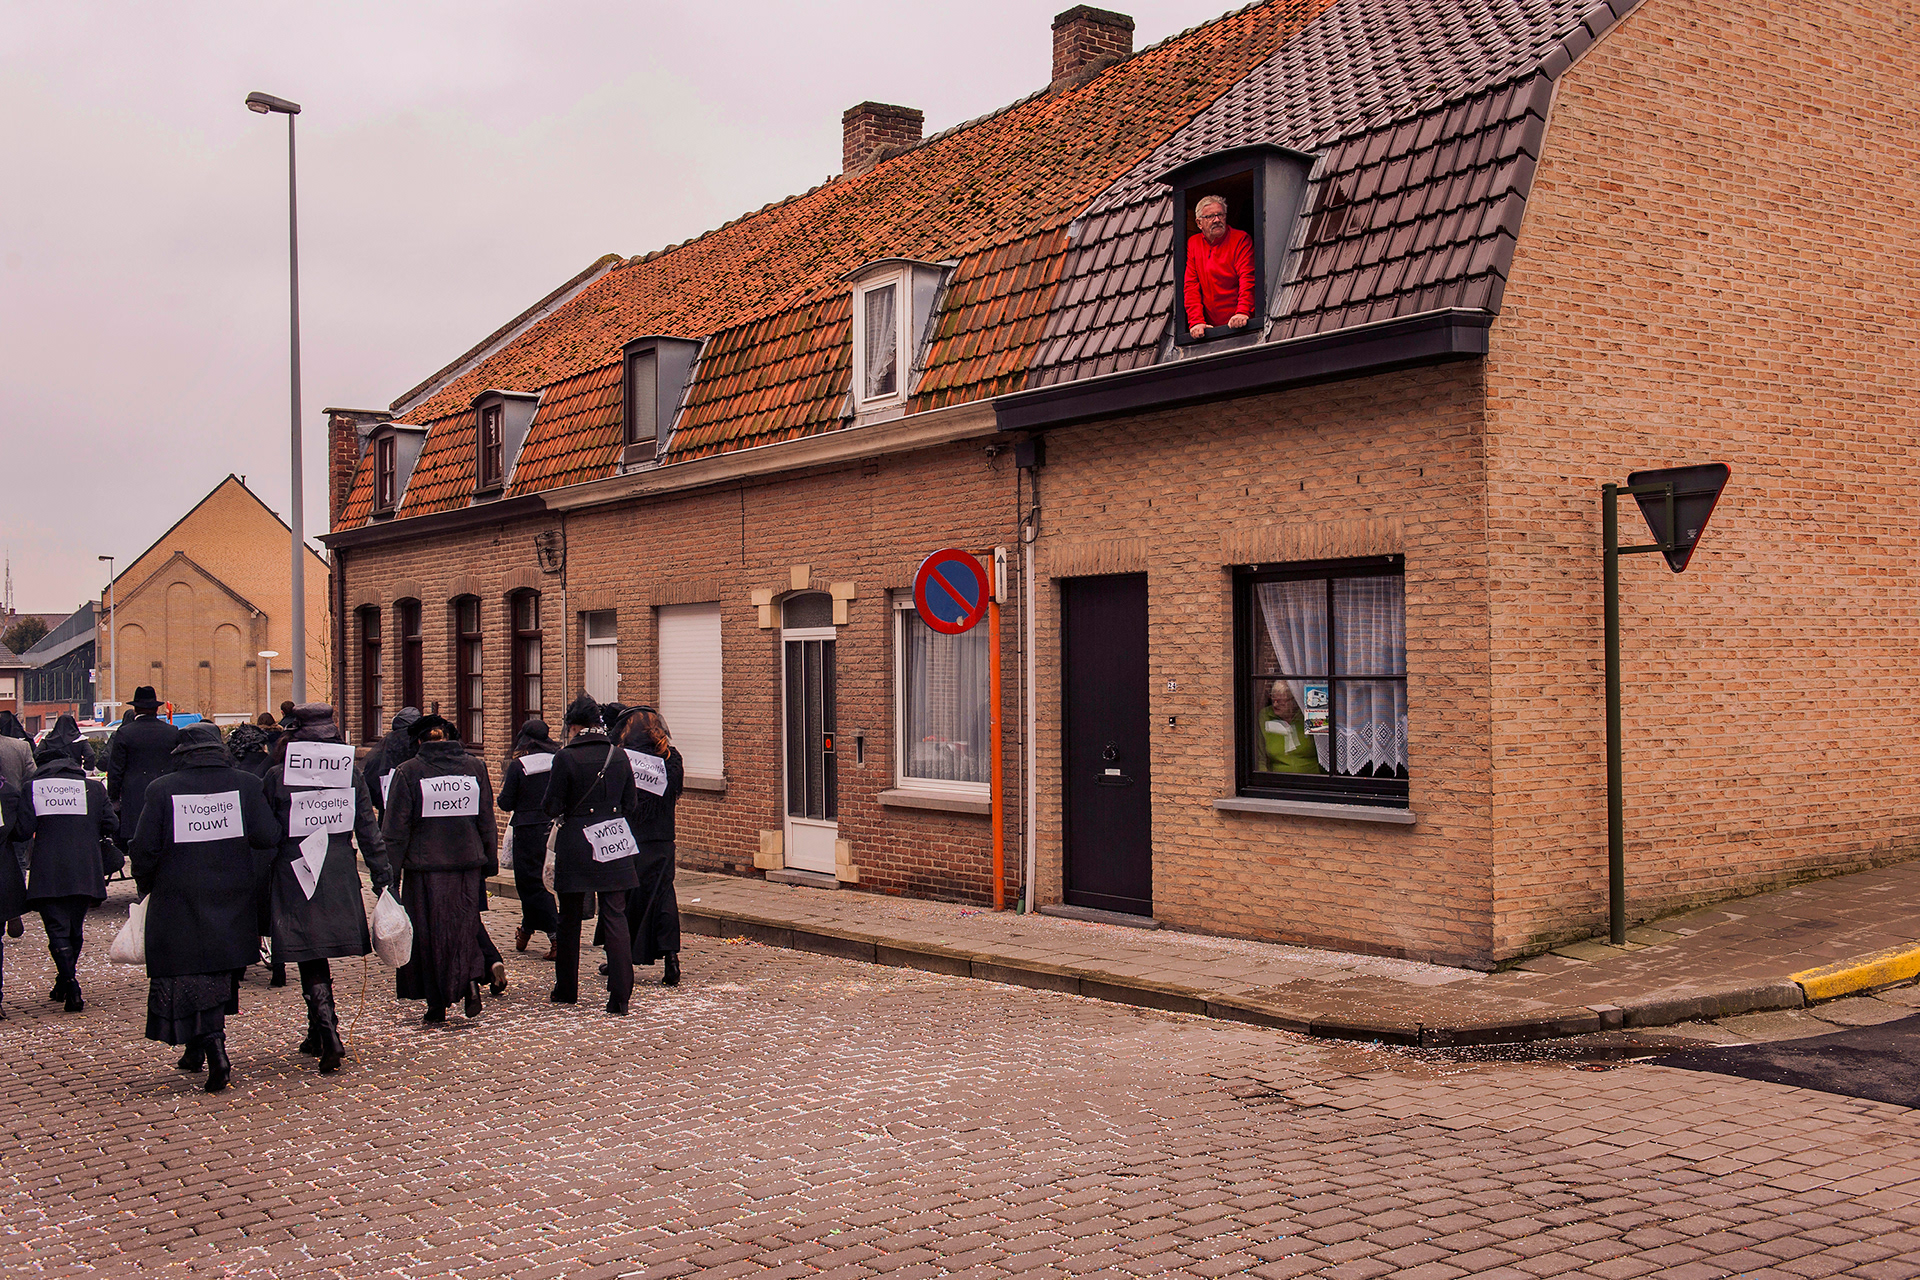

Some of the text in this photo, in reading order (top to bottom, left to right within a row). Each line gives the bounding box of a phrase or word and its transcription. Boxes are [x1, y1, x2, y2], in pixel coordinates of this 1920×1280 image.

[289, 754, 352, 771] En nu?
[633, 771, 659, 785] ouwt
[46, 786, 80, 795] Vogeltje
[45, 797, 77, 807] rouwt
[189, 802, 234, 815] Vogeltje
[307, 797, 349, 810] Vogeltje
[433, 796, 471, 810] next?
[188, 816, 229, 831] rouwt
[304, 812, 343, 826] rouwt
[600, 838, 630, 855] next?
